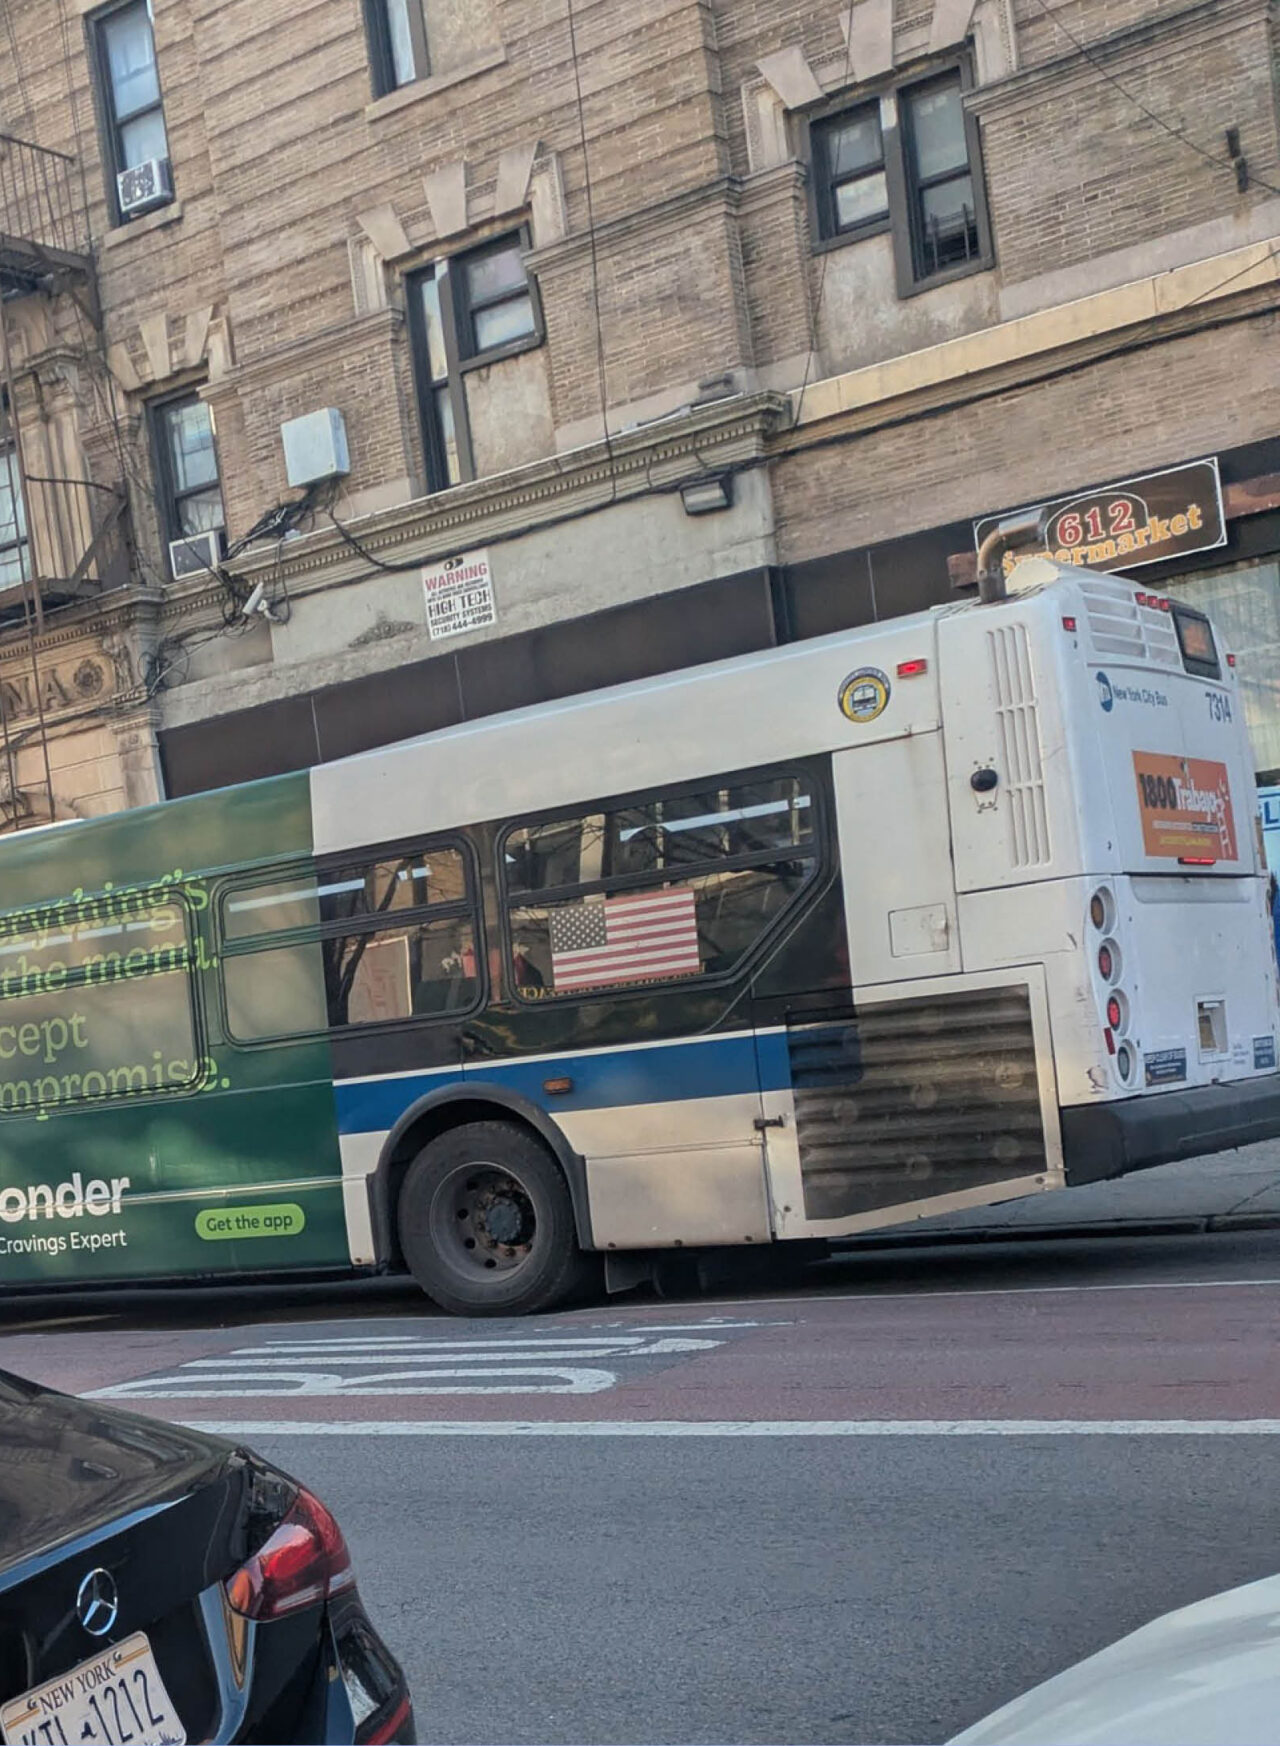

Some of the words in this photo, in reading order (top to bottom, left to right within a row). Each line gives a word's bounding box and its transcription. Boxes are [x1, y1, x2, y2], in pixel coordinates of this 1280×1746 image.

[1057, 500, 1135, 547] 612
[425, 563, 487, 591] WARNING
[428, 600, 457, 618] HIGH
[459, 589, 491, 608] TECH
[1205, 692, 1232, 722] 7314
[2, 955, 68, 998] the
[206, 1217, 233, 1232] Get
[235, 1215, 260, 1229] the
[263, 1214, 293, 1231] app
[70, 1230, 127, 1252] Expert
[39, 1680, 75, 1715] NEW
[76, 1658, 116, 1693] YORK
